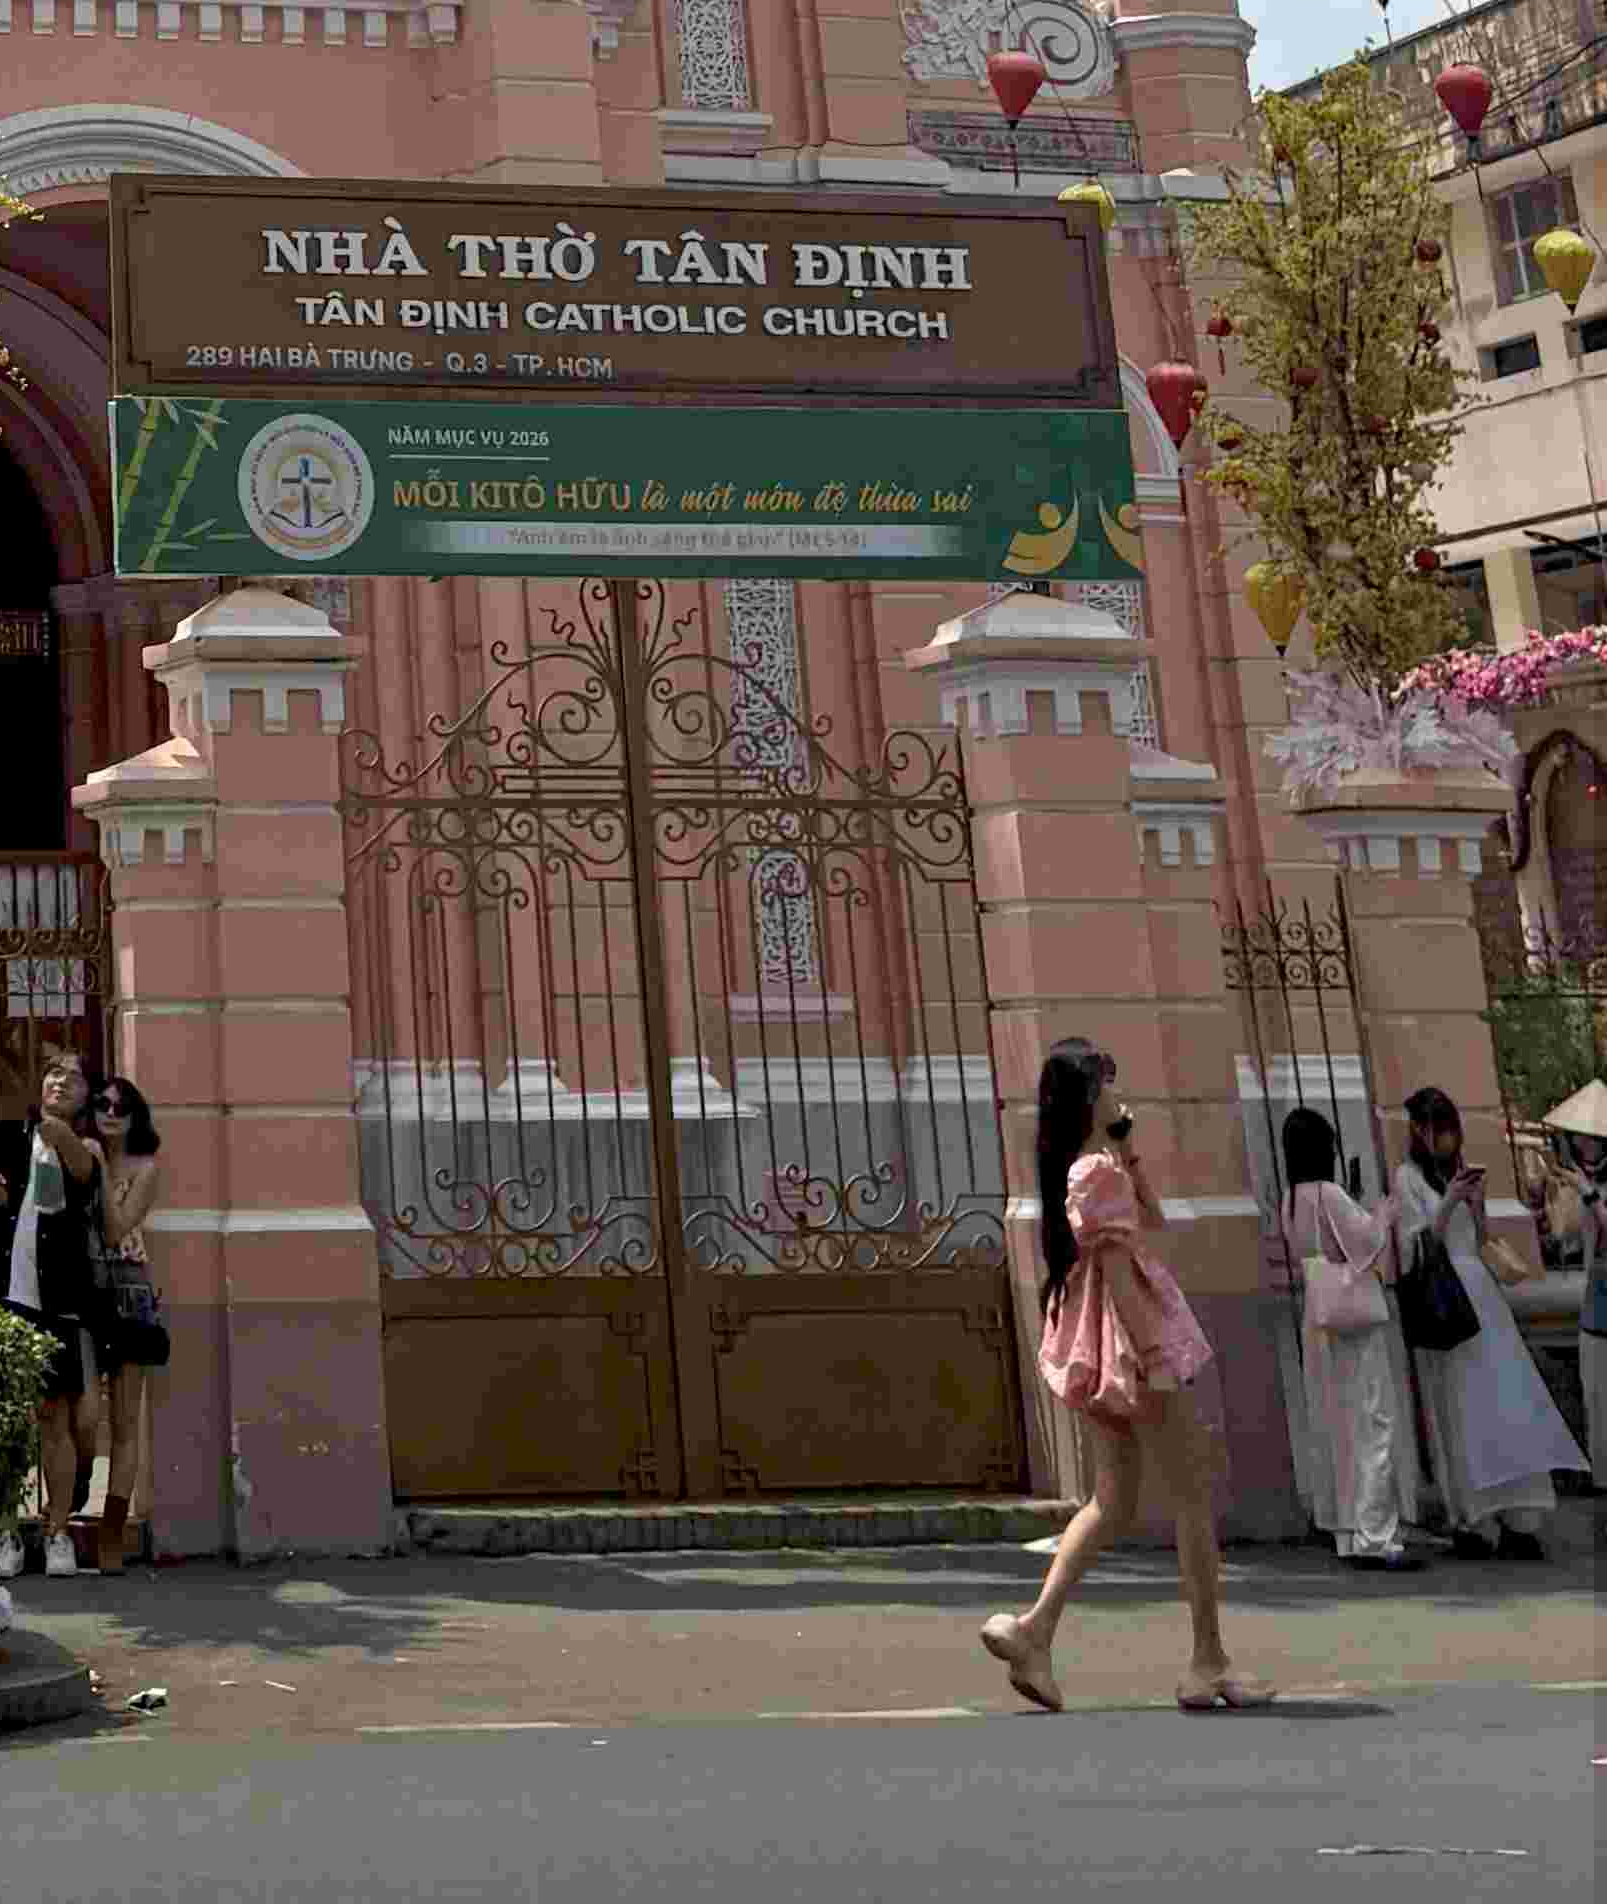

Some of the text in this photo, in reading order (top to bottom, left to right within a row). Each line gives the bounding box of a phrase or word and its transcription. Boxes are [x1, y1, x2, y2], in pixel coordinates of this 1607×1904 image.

[261, 215, 972, 298] NHÀ THỜ TÂN ĐỊNH
[295, 290, 948, 339] TÂN ĐỊNH CATHOLIC CHURCH
[186, 345, 233, 367] 289
[241, 347, 282, 368] HAI
[288, 342, 321, 368] BÀ
[327, 348, 413, 372] TRƯNG
[447, 352, 489, 374] Q.3
[388, 424, 550, 448] NĂM MỤC VỤ 2026
[393, 467, 460, 509] MỖI
[470, 473, 546, 510] KITÔ
[555, 475, 631, 511] HỮU
[642, 479, 668, 512] là
[682, 481, 735, 521] một
[746, 481, 805, 512] môn
[930, 483, 973, 512] sai
